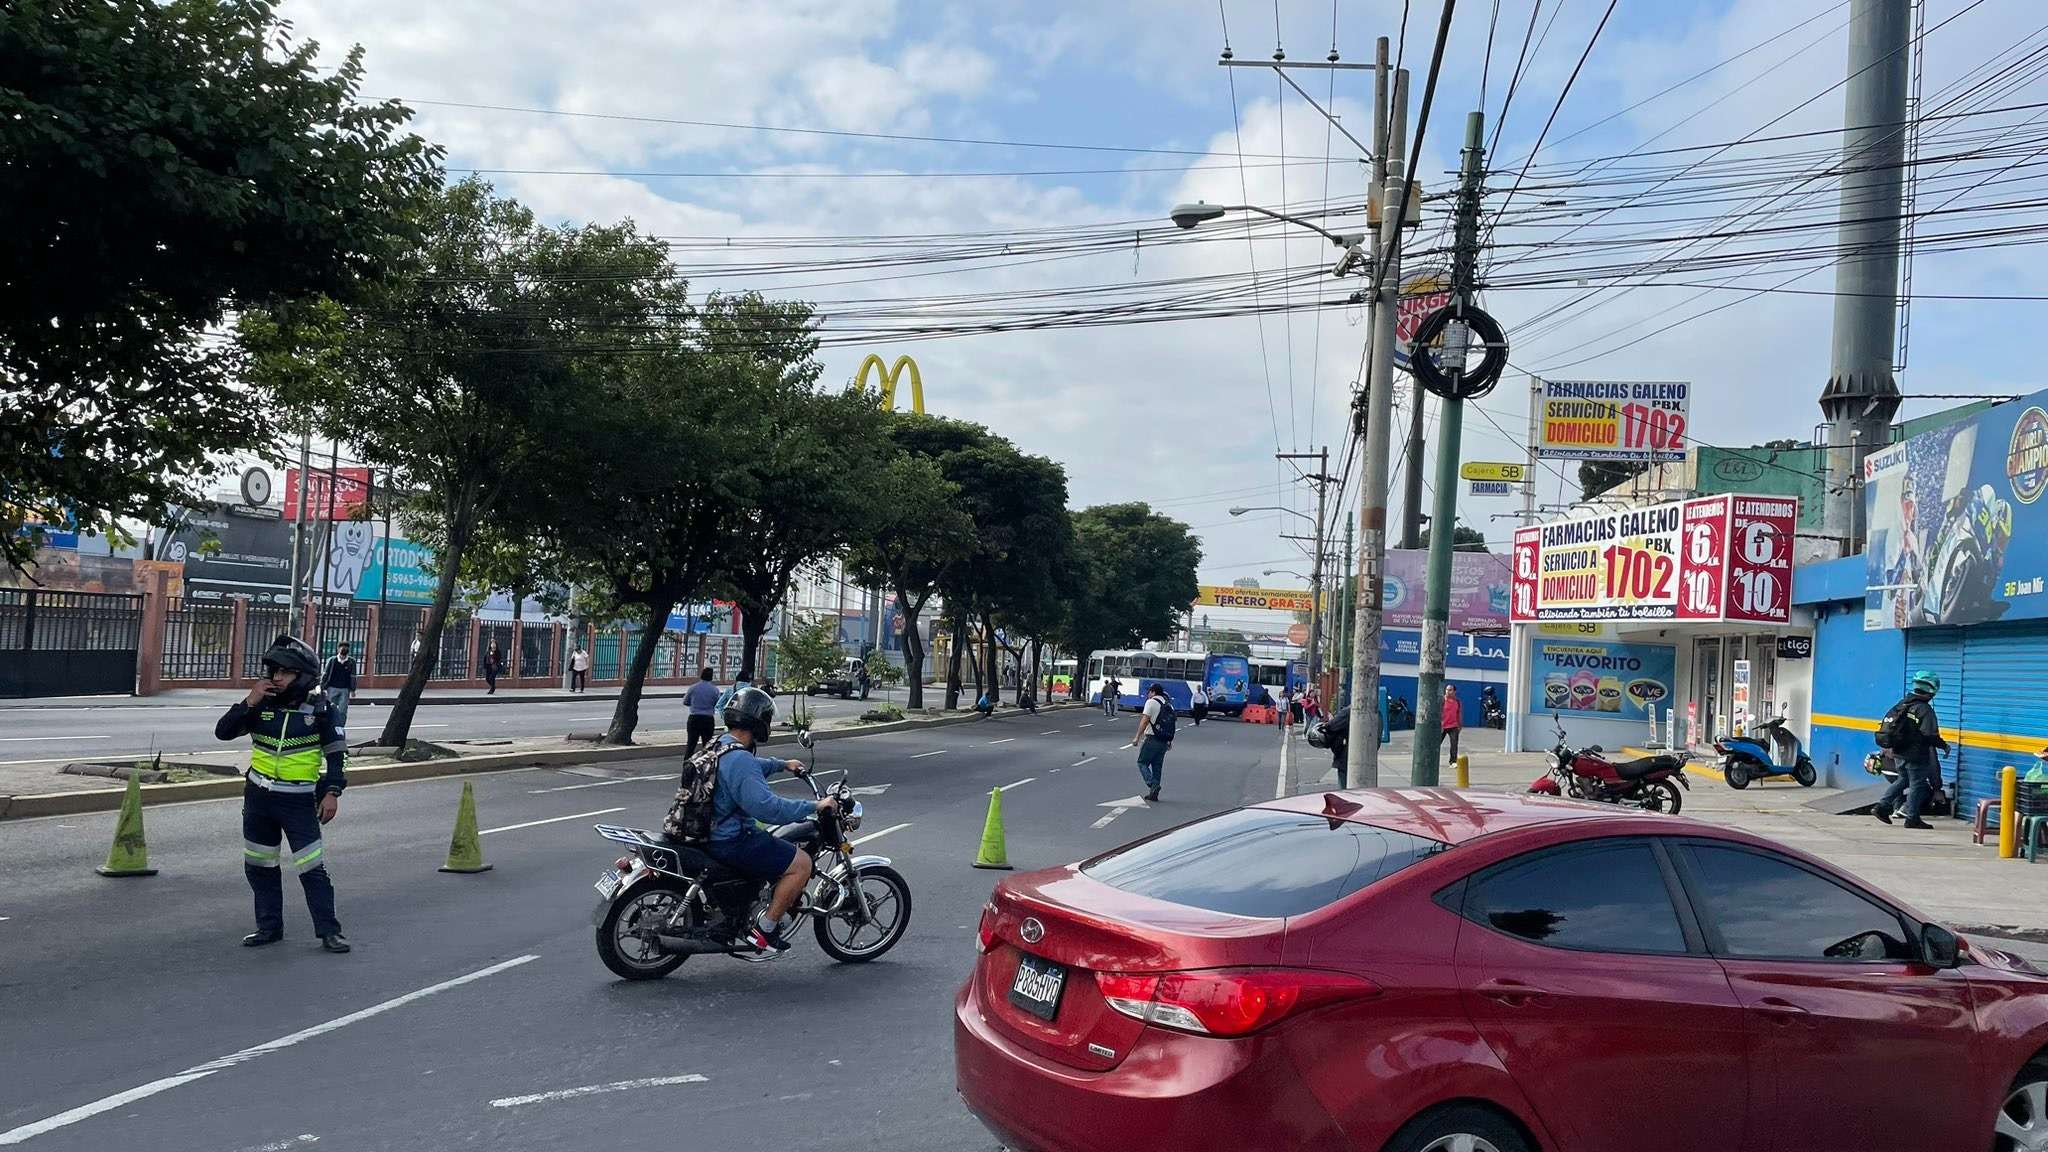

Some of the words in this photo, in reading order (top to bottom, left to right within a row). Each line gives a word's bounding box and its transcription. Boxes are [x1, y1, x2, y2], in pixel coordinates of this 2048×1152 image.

[1546, 382, 1628, 399] FARMACIAS
[1632, 383, 1686, 400] GALENO
[1548, 401, 1605, 419] SERVICIO
[1608, 401, 1616, 419] A
[1547, 422, 1616, 444] DOMICILIO
[1621, 401, 1685, 449] 1702
[1874, 450, 1904, 472] SUZUKI
[1501, 466, 1519, 478] 5B
[1471, 483, 1508, 493] FARMACIA
[1735, 501, 1745, 515] LE
[1745, 502, 1793, 518] ATENDEMOS
[1542, 516, 1616, 547] FARMACIAS
[1620, 506, 1679, 537] GALENO
[1645, 537, 1675, 555] PBX.
[1691, 523, 1711, 564] 6
[1744, 522, 1774, 564] 6
[1519, 547, 1531, 579] 6
[1544, 551, 1587, 572] SERVICIO
[1590, 549, 1597, 569] A
[1603, 544, 1674, 600] 1702
[1734, 568, 1743, 577] A
[1235, 588, 1260, 596] ofertas
[1261, 590, 1299, 599] semanales
[1542, 573, 1596, 601] DOMICILIO
[1687, 571, 1709, 612] 10
[1740, 571, 1773, 613] 10
[2004, 582, 2017, 597] 36
[2017, 580, 2032, 595] Joan
[2032, 576, 2044, 593] Mir
[1214, 594, 1267, 607] TERCERO
[1517, 583, 1531, 615] 10
[1580, 608, 1617, 619] también
[1632, 606, 1674, 618] bolsillo
[1769, 608, 1786, 617] P.M.
[1578, 622, 1596, 633] 5B
[1456, 646, 1510, 659] BAJA
[1543, 653, 1554, 661] TU
[1555, 653, 1641, 671] FAVORITO
